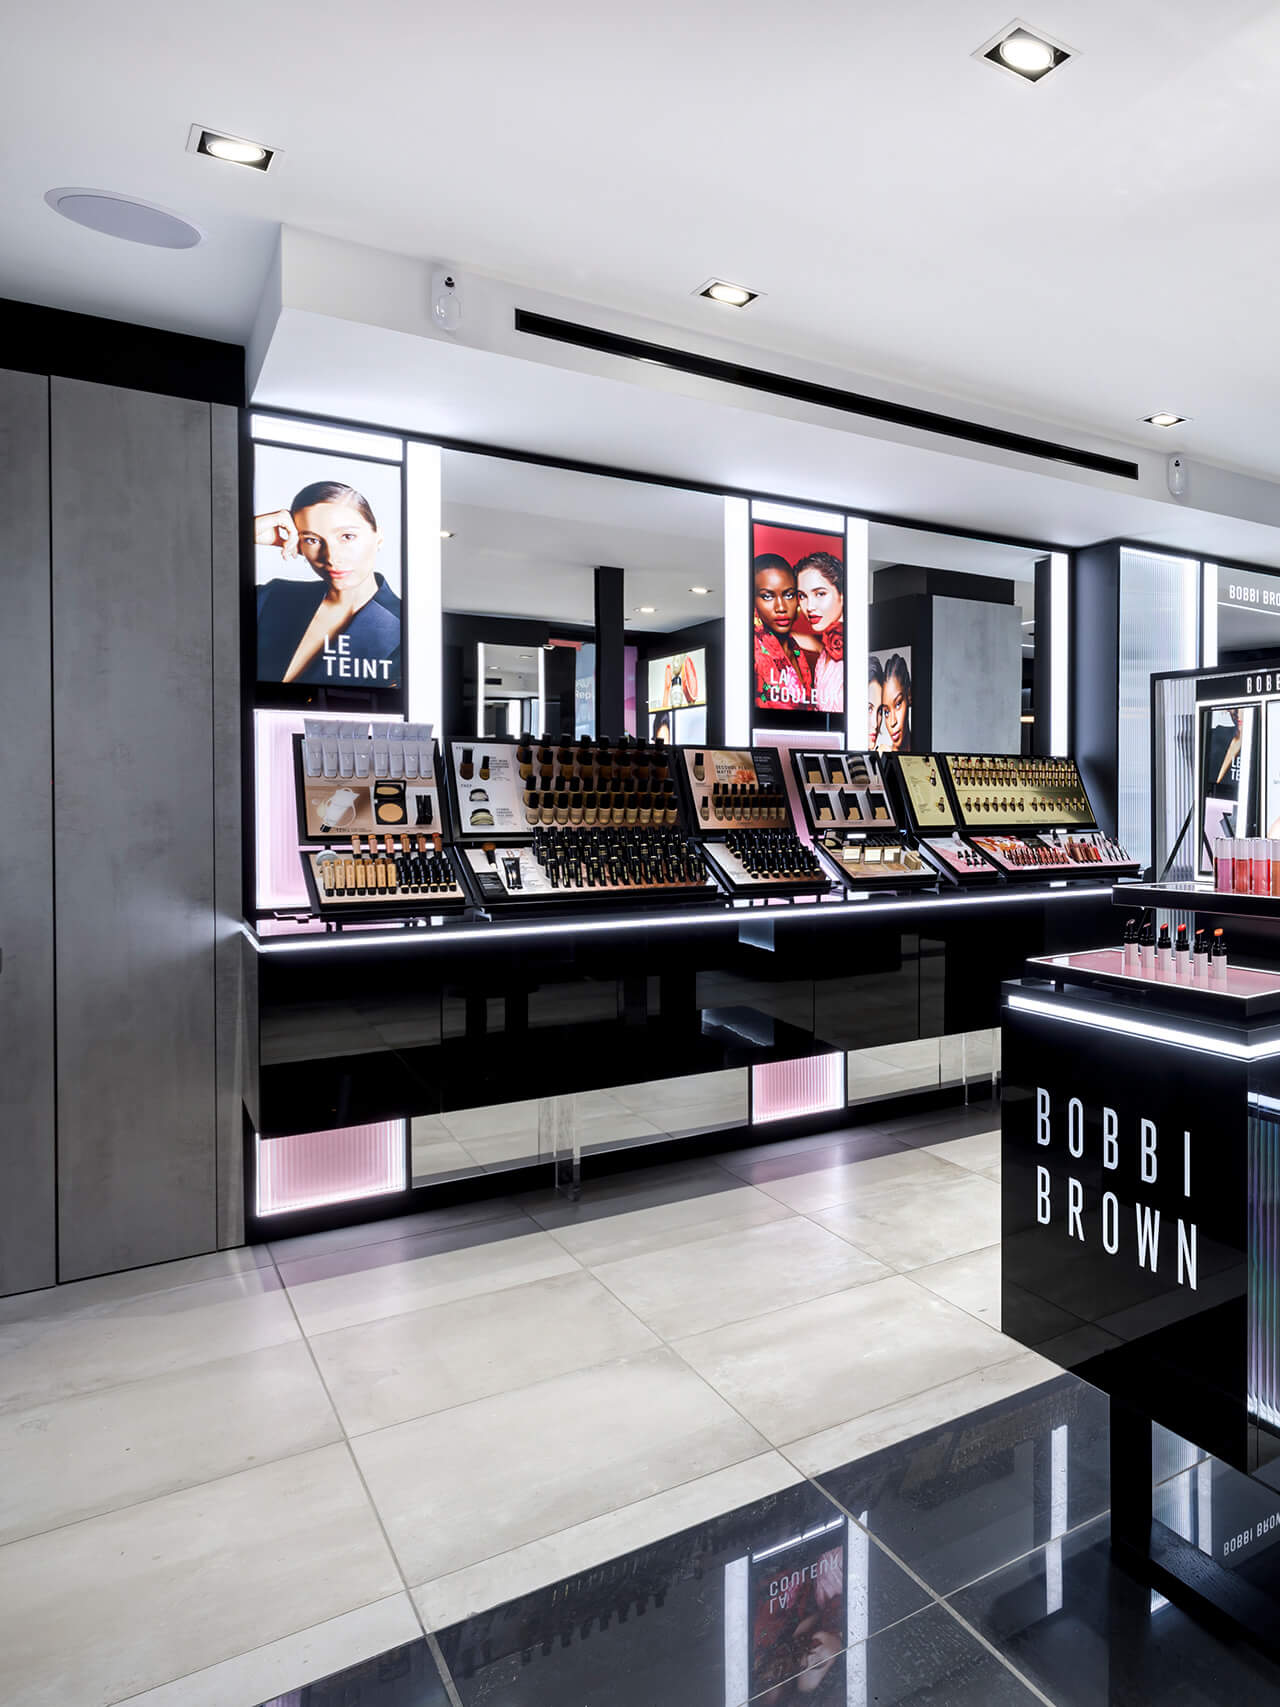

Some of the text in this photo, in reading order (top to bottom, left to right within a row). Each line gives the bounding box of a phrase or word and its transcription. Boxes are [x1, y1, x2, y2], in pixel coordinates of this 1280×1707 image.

[1229, 584, 1260, 603] BOBBI
[324, 634, 351, 655] LE
[322, 655, 393, 680] TEINT
[770, 667, 788, 685] LA
[1036, 1086, 1191, 1198] BOBBI
[1036, 1165, 1197, 1291] BROWN
